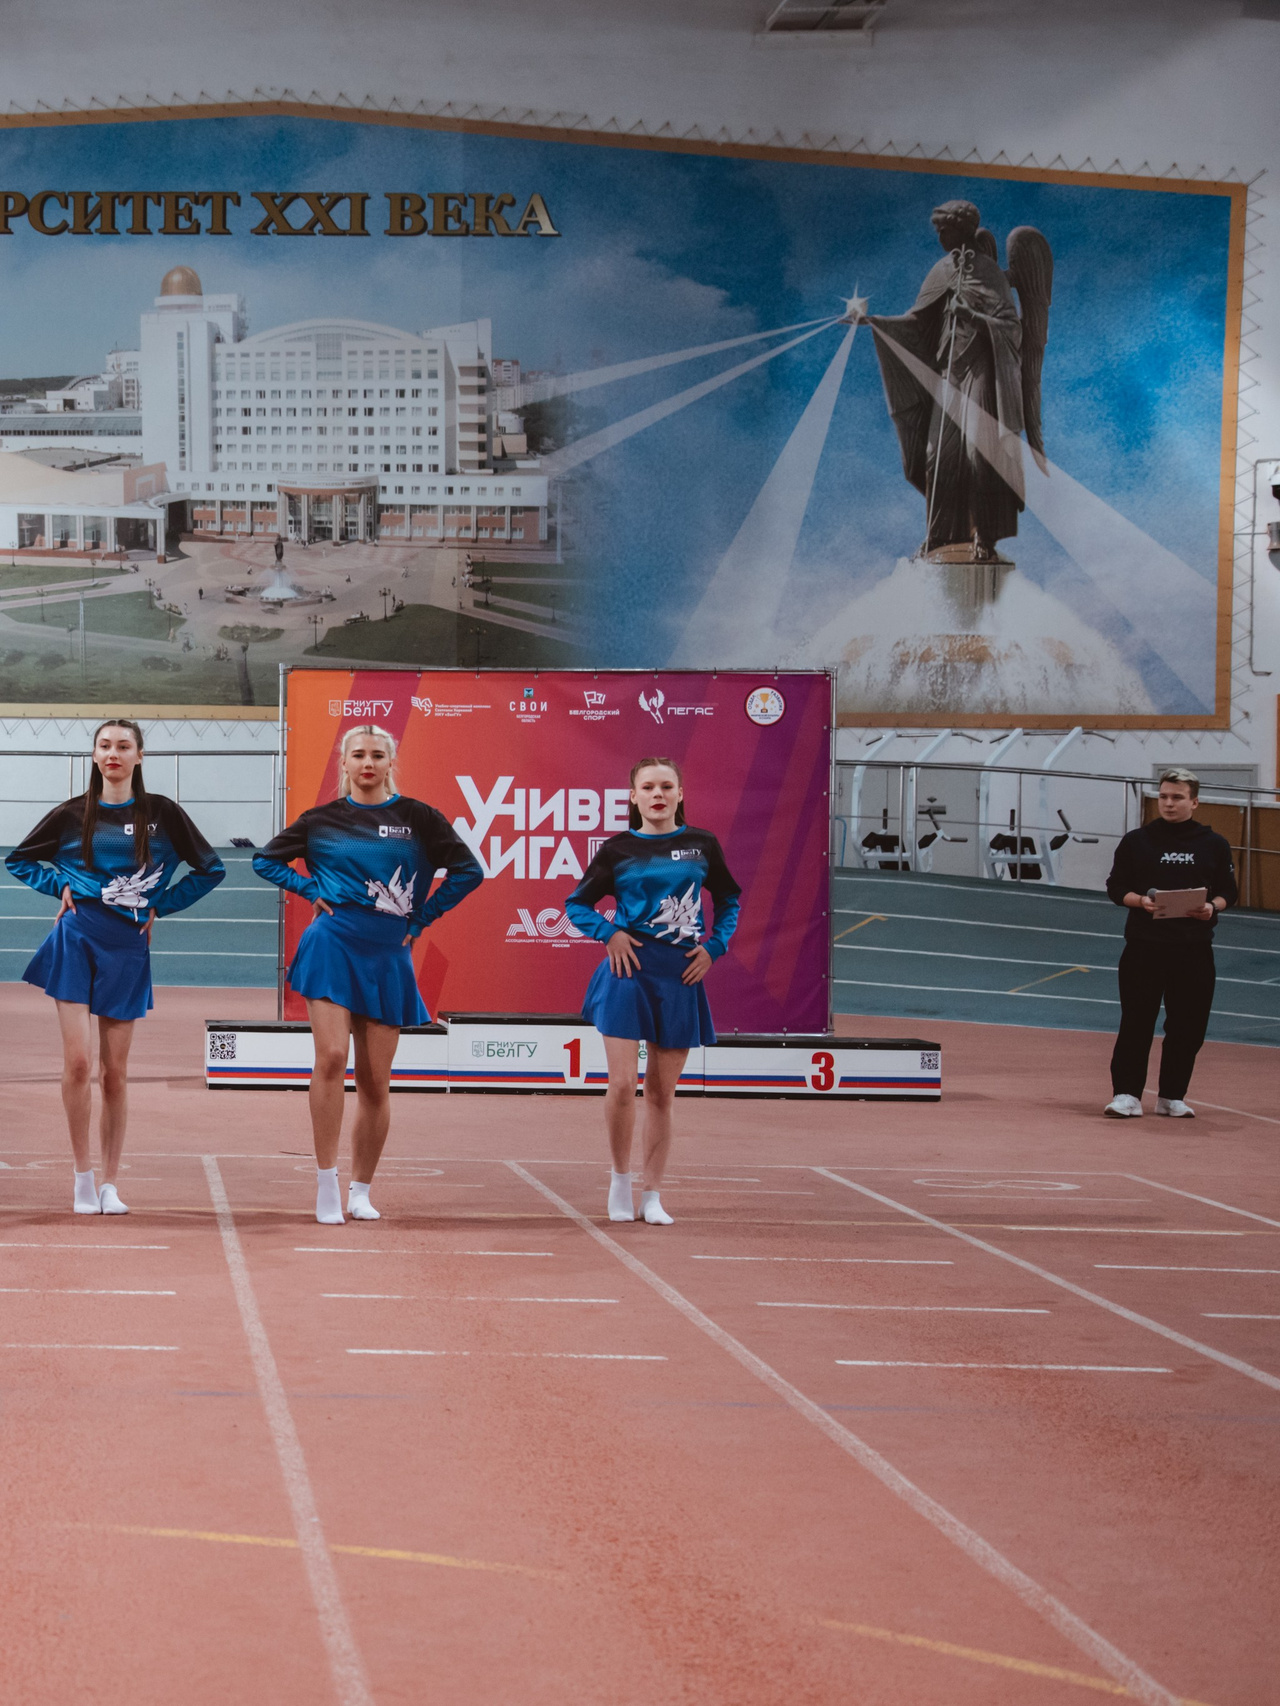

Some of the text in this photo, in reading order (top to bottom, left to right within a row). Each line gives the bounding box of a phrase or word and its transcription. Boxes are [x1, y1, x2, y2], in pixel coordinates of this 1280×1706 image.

[384, 192, 562, 237] ВЕКА
[343, 702, 393, 717] БелГУ
[509, 701, 548, 711] СВОИ
[667, 707, 714, 715] ПЕГАС
[486, 1043, 538, 1058] БелГУ
[563, 1038, 581, 1078] 1
[811, 1051, 835, 1092] 3
[912, 1178, 1082, 1191] 8
